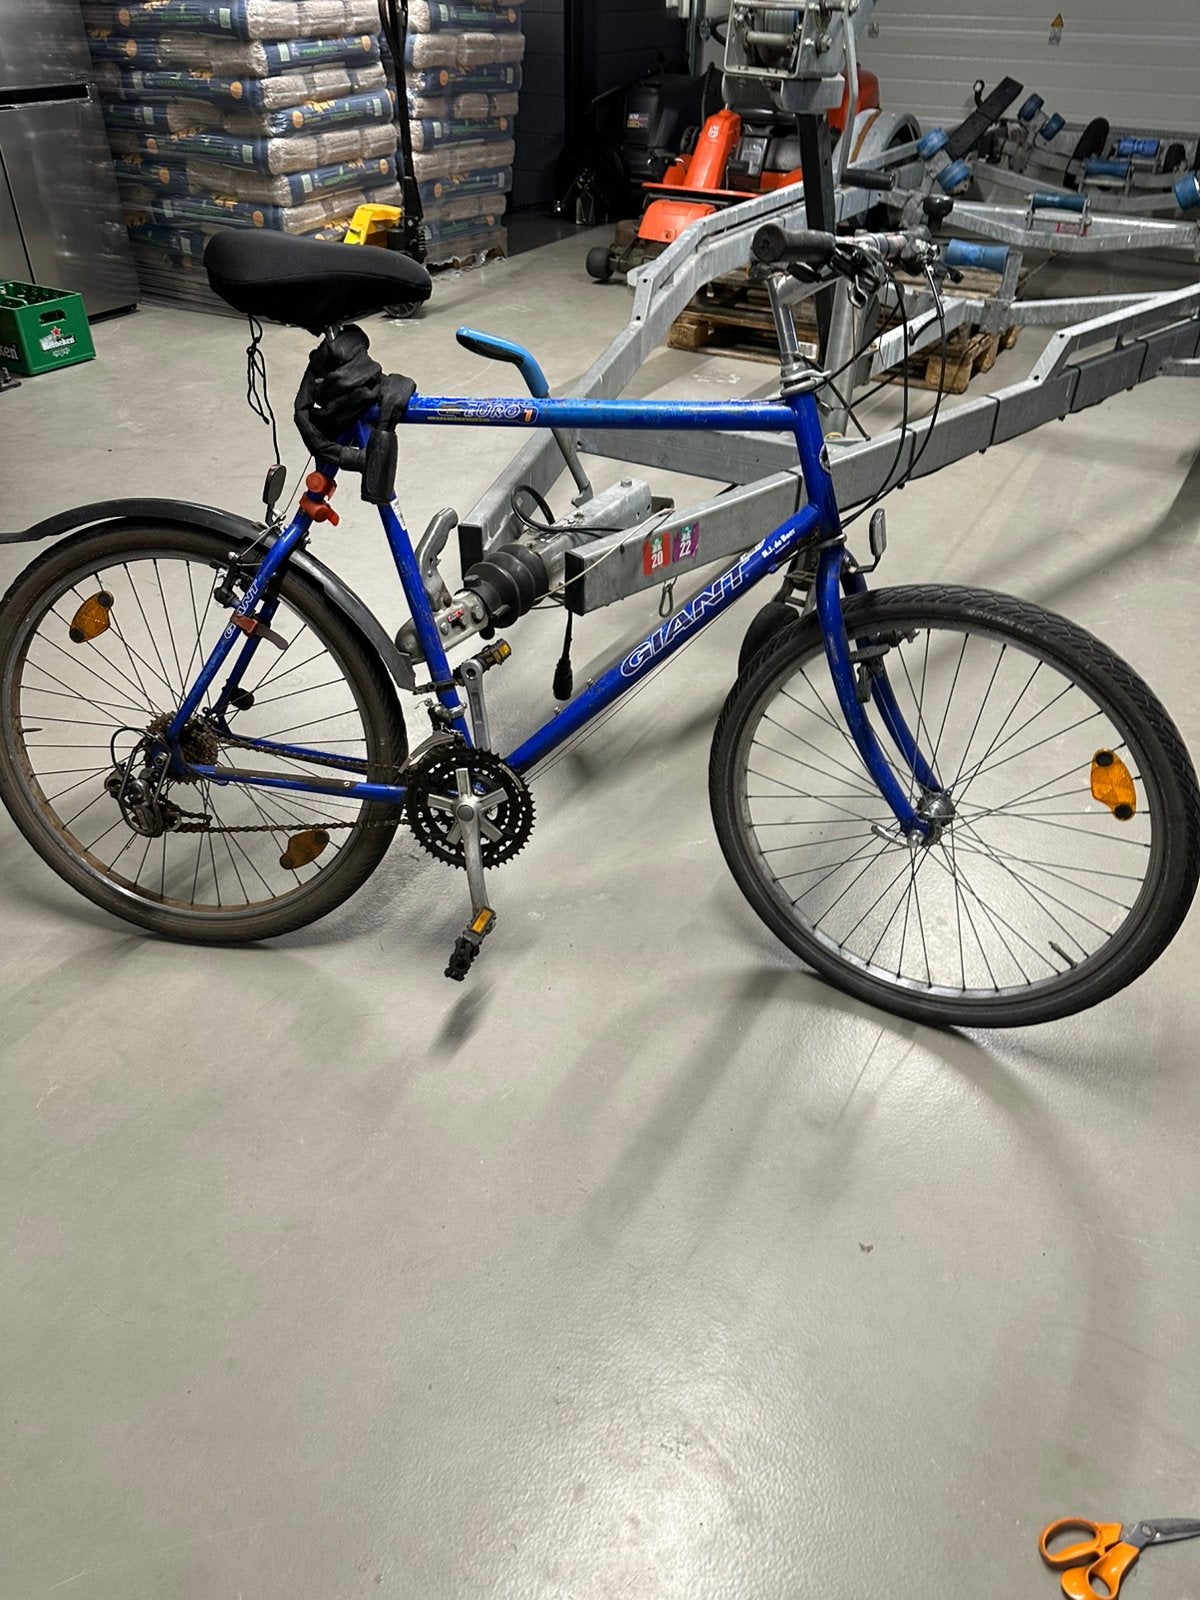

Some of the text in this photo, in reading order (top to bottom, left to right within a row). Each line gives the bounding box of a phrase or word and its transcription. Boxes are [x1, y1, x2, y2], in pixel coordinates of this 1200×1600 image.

[464, 402, 533, 423] EURO 1
[679, 540, 692, 558] 22
[651, 551, 664, 569] 20
[224, 578, 259, 640] GANT
[620, 562, 747, 678] GIANT
